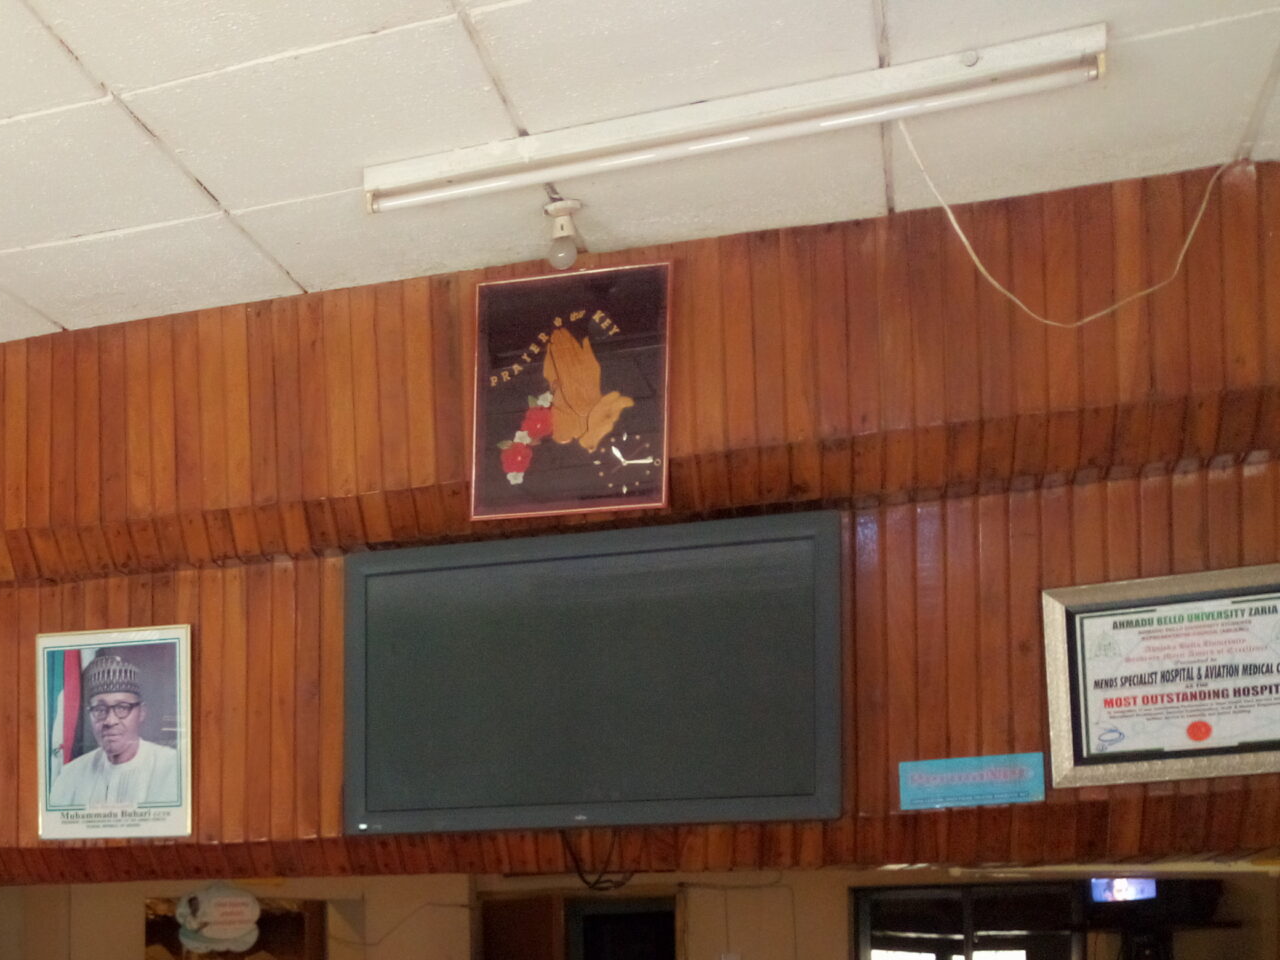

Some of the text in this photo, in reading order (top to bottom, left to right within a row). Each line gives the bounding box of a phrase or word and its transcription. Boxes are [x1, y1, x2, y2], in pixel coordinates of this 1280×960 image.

[489, 309, 620, 387] PRAYER KEY
[1112, 604, 1278, 630] AHMADU BELLO UNIVERSITY ZARIA
[1093, 678, 1118, 690] MENDS
[1120, 671, 1157, 688] SPECIALIST
[1160, 667, 1194, 683] HOSPITAL
[1196, 668, 1202, 680] &
[1204, 663, 1240, 679] AVIATION
[1241, 662, 1274, 676] MEDICAL
[1103, 683, 1280, 709] MOST OUTSTANDING HOSPIT
